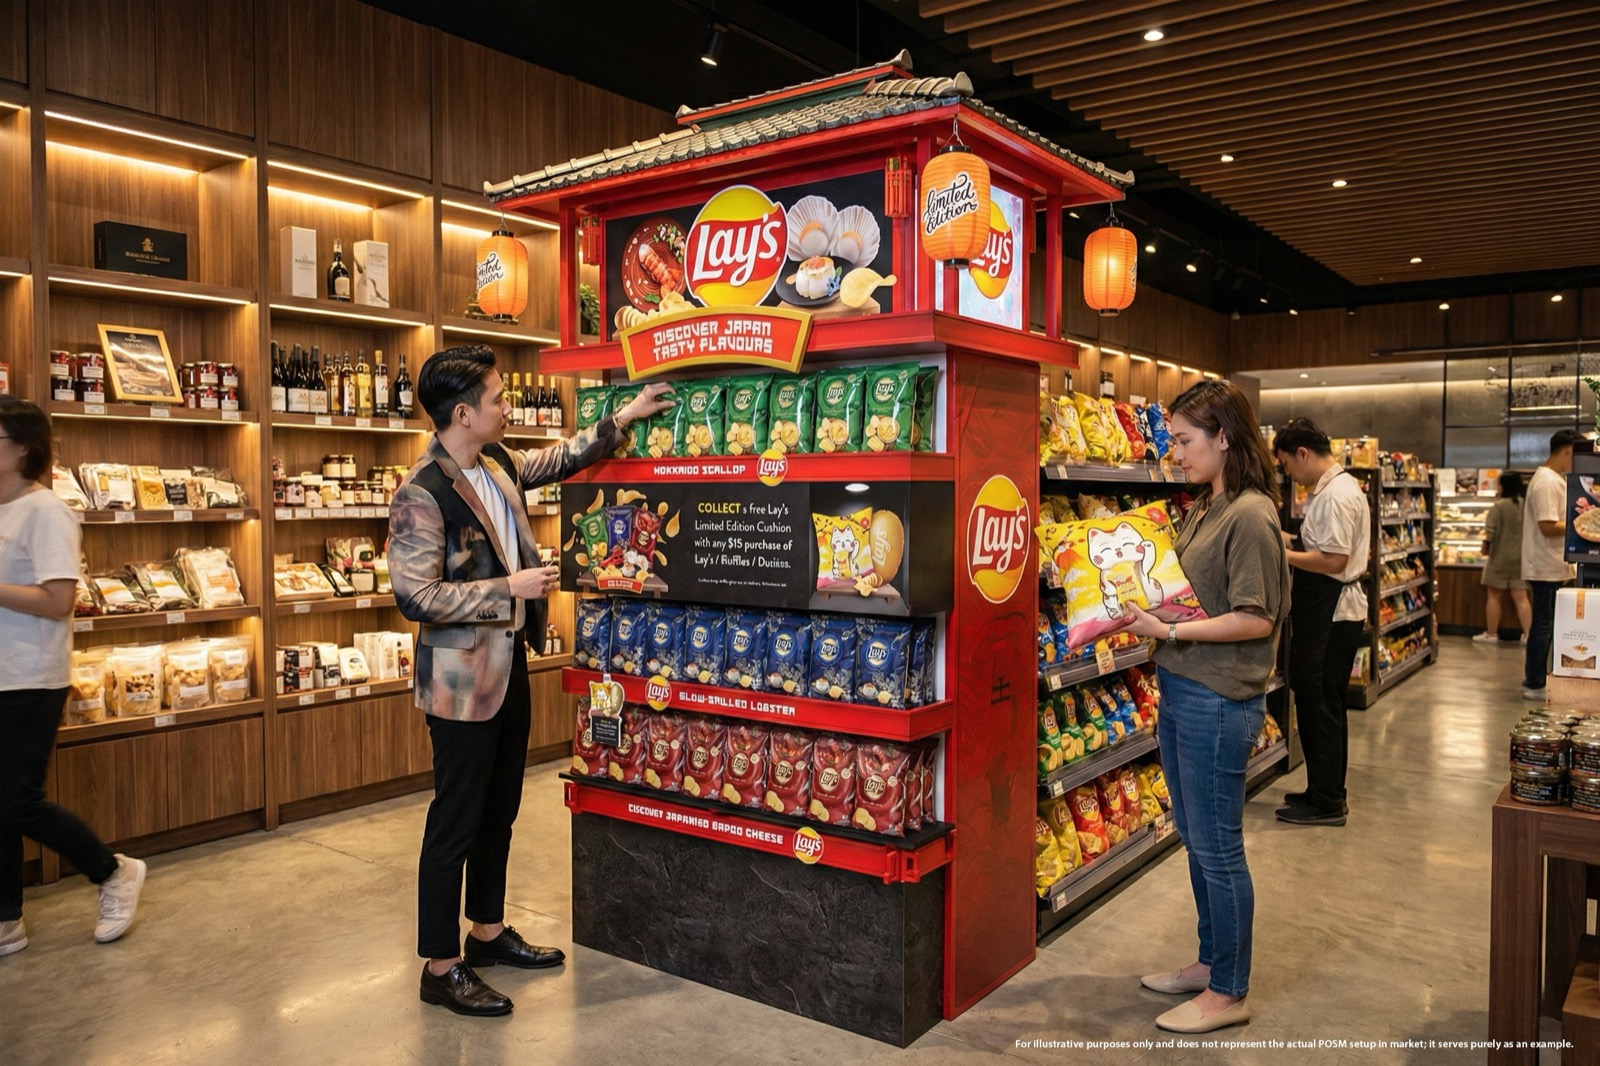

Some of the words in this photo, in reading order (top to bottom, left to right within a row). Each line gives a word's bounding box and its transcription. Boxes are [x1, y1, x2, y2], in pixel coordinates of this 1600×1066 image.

[692, 213, 782, 287] Lay's
[653, 320, 719, 346] DISCOVER
[724, 320, 772, 336] JAPAN
[653, 340, 696, 362] TASTY
[699, 336, 773, 354] FLAVOURS
[702, 465, 746, 475] SCALLOP
[698, 502, 741, 514] COLLECT
[749, 502, 766, 515] free
[768, 503, 789, 519] Lay's
[695, 520, 724, 532] Limited
[726, 520, 755, 532] Edition
[757, 521, 792, 533] Cushion
[694, 537, 711, 548] with
[712, 540, 727, 552] any
[728, 537, 743, 549] $15
[744, 539, 781, 553] purchase
[783, 539, 793, 551] of
[973, 506, 1027, 573] Lay's
[745, 828, 784, 845] CHEESE
[795, 834, 821, 857] Lay's
